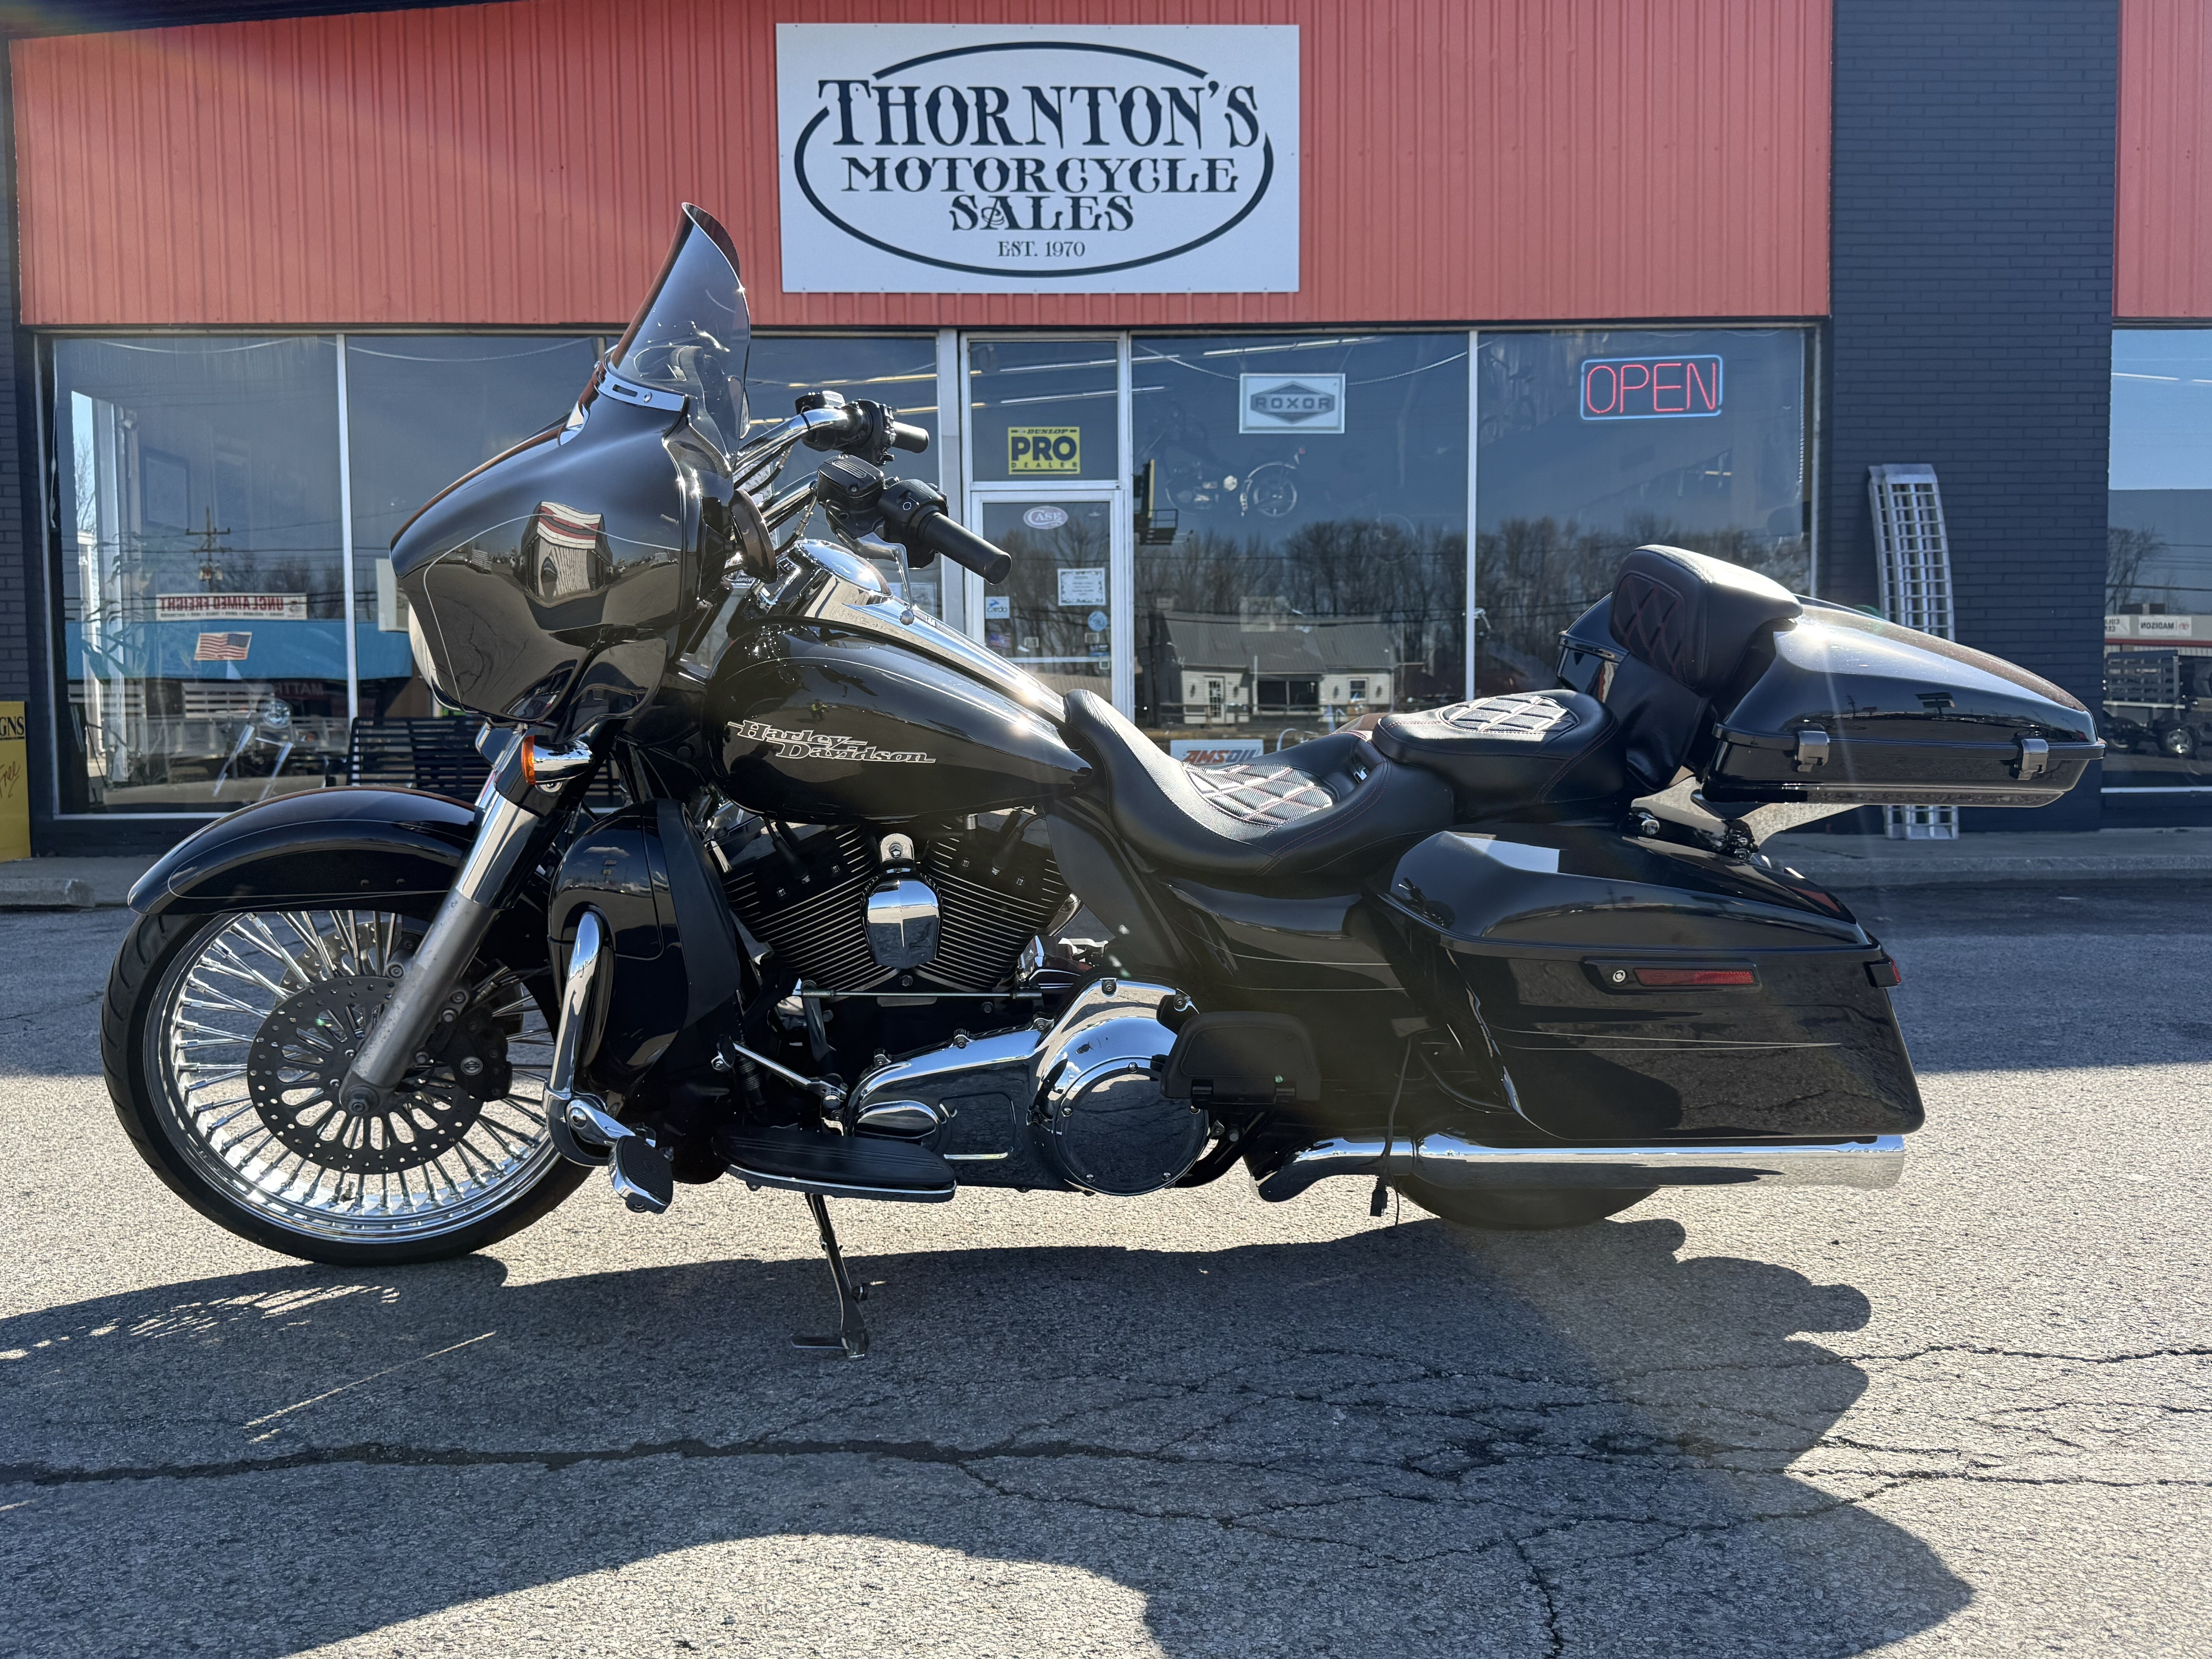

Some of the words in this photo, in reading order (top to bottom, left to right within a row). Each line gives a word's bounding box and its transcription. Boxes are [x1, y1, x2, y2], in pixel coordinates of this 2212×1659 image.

[818, 79, 1260, 150] THORNTON'S
[841, 157, 1238, 193] MOTORCYCLE
[949, 194, 1134, 232] SALES
[997, 241, 1038, 257] EST.
[1044, 241, 1086, 258] 1970
[1255, 397, 1331, 409] ROXOR
[1586, 362, 1717, 414] OPEN
[1011, 436, 1077, 461] PRO
[767, 737, 936, 763] Davidson
